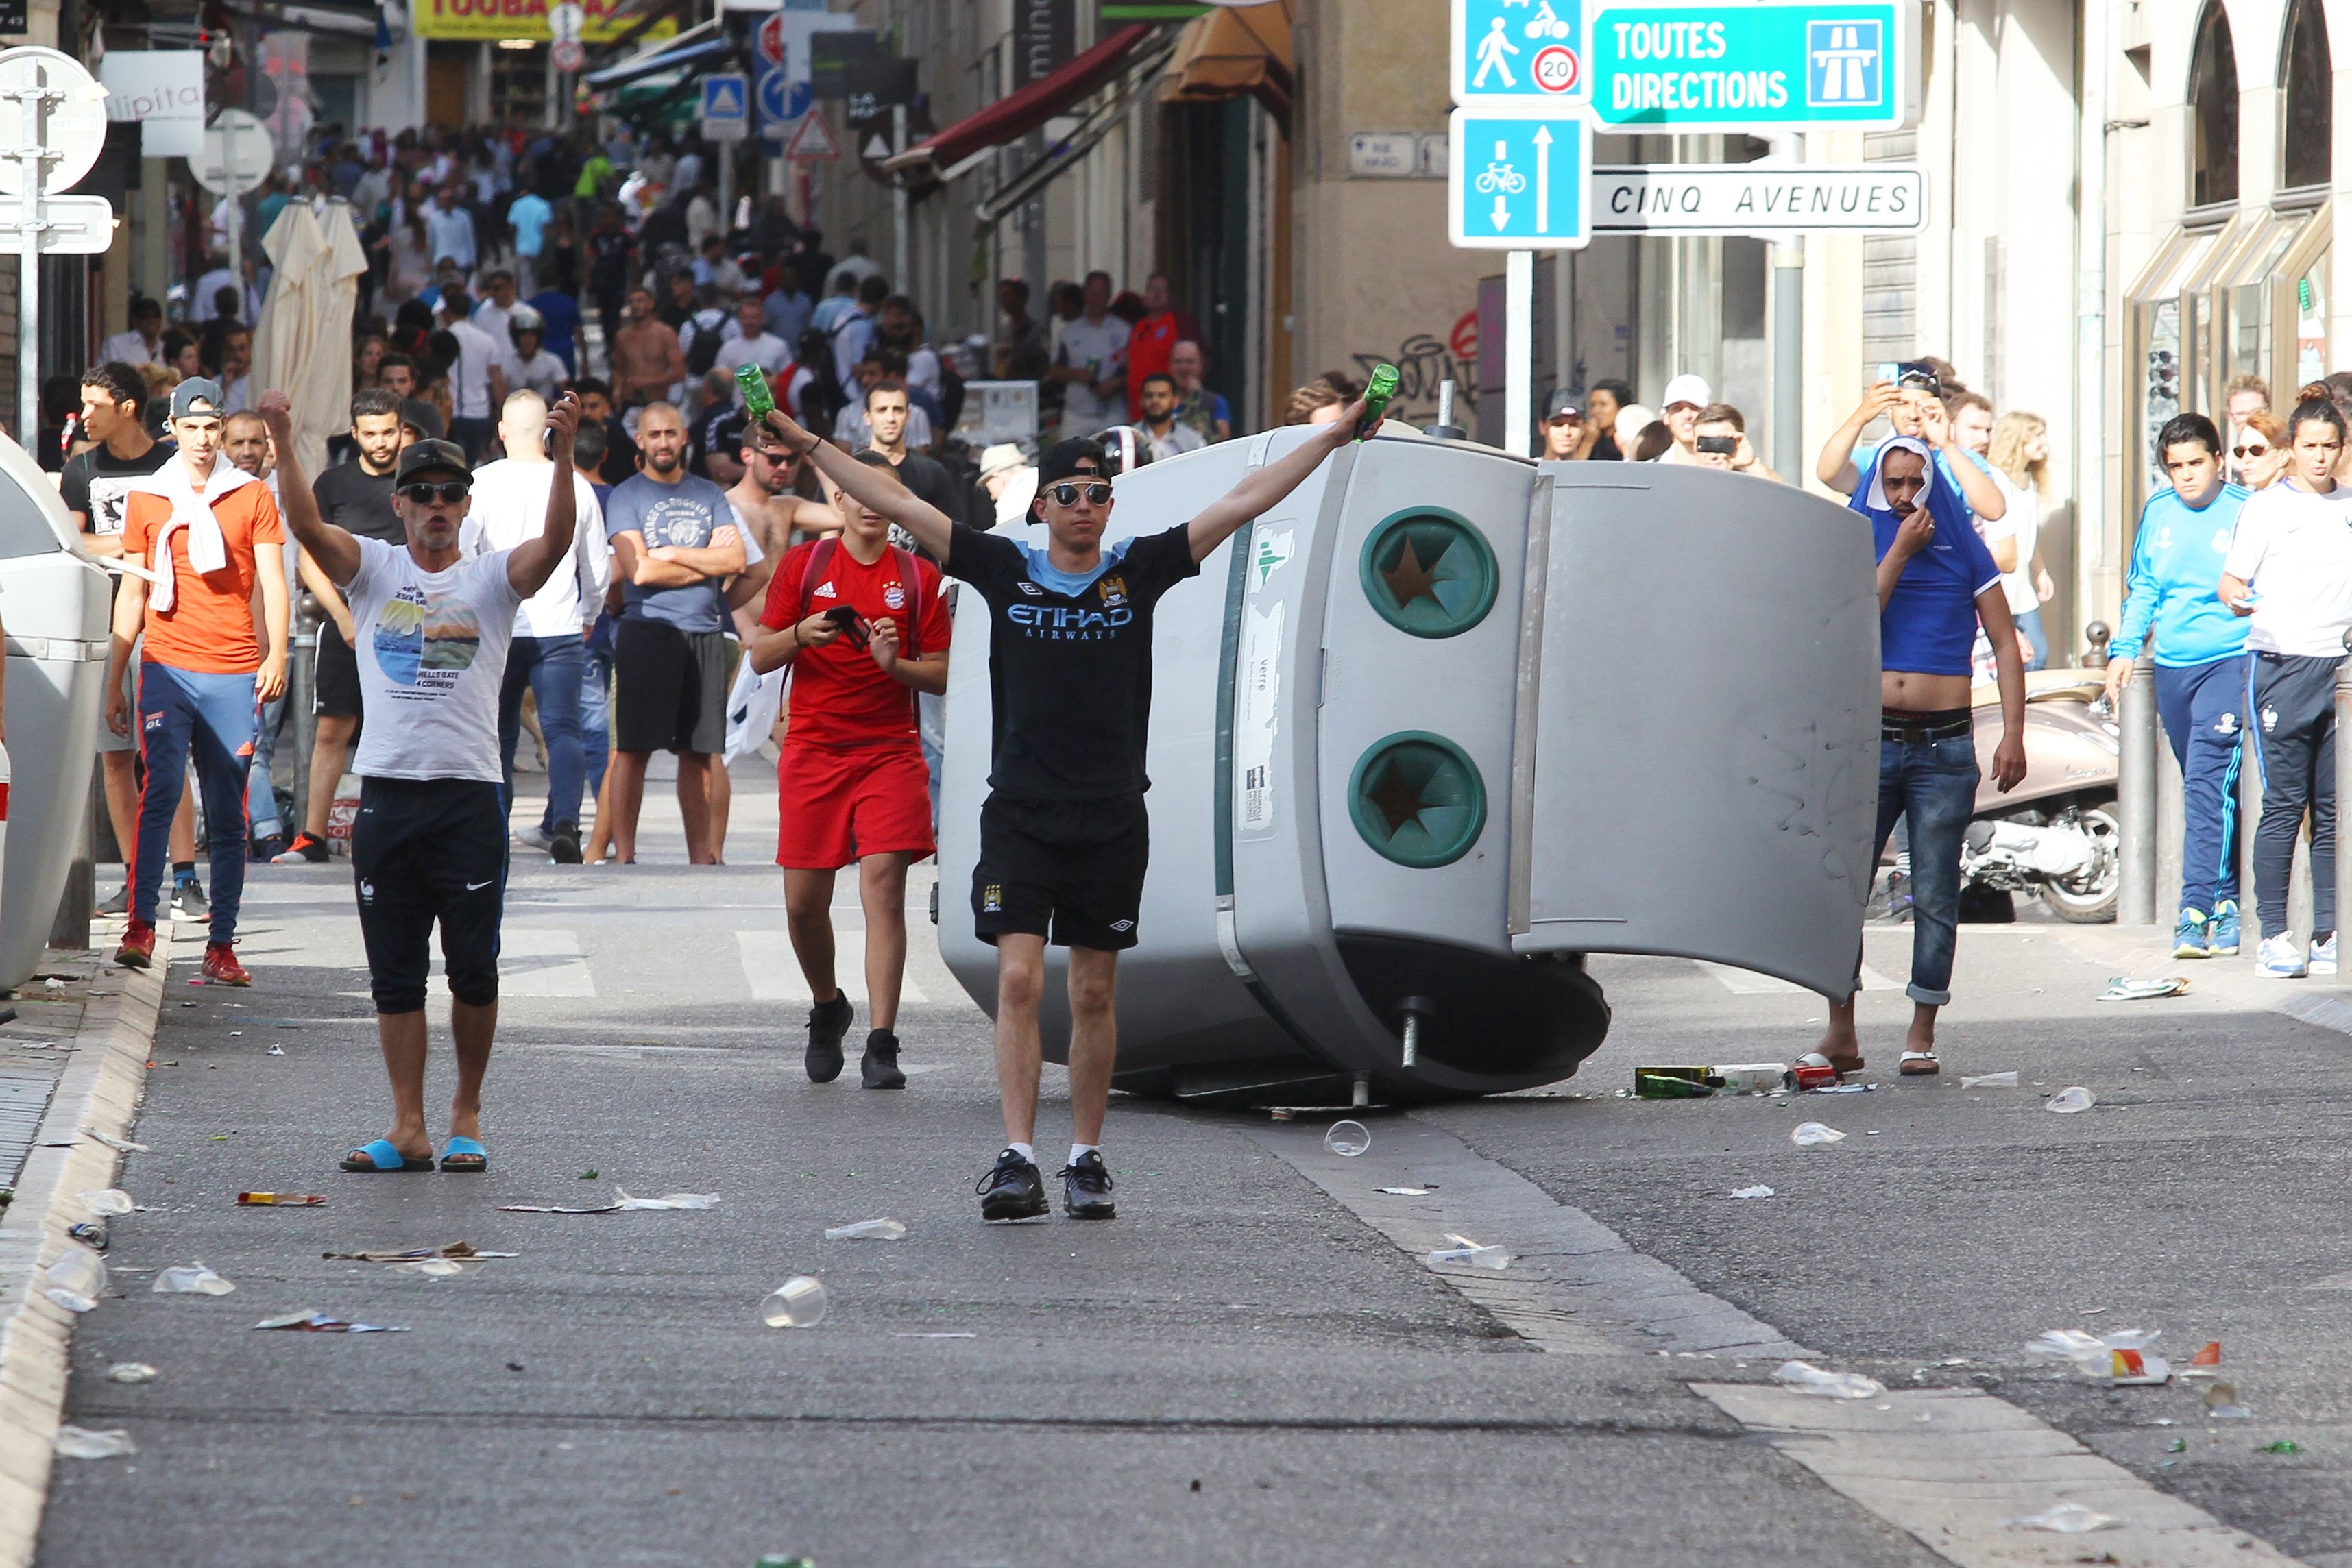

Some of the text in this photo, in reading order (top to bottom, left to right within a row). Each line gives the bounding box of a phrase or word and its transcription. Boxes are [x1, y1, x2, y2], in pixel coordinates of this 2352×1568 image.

[1613, 23, 1725, 59] TOUTES
[1543, 61, 1568, 77] 20
[1612, 71, 1788, 109] DIRECTIONS
[1611, 186, 1907, 214] CINQ AVENUES
[1008, 604, 1132, 628] ETIHAD
[1026, 628, 1115, 640] AIRWAYS
[422, 681, 454, 689] CORNERS
[1258, 659, 1268, 691] verre
[146, 718, 162, 730] OL
